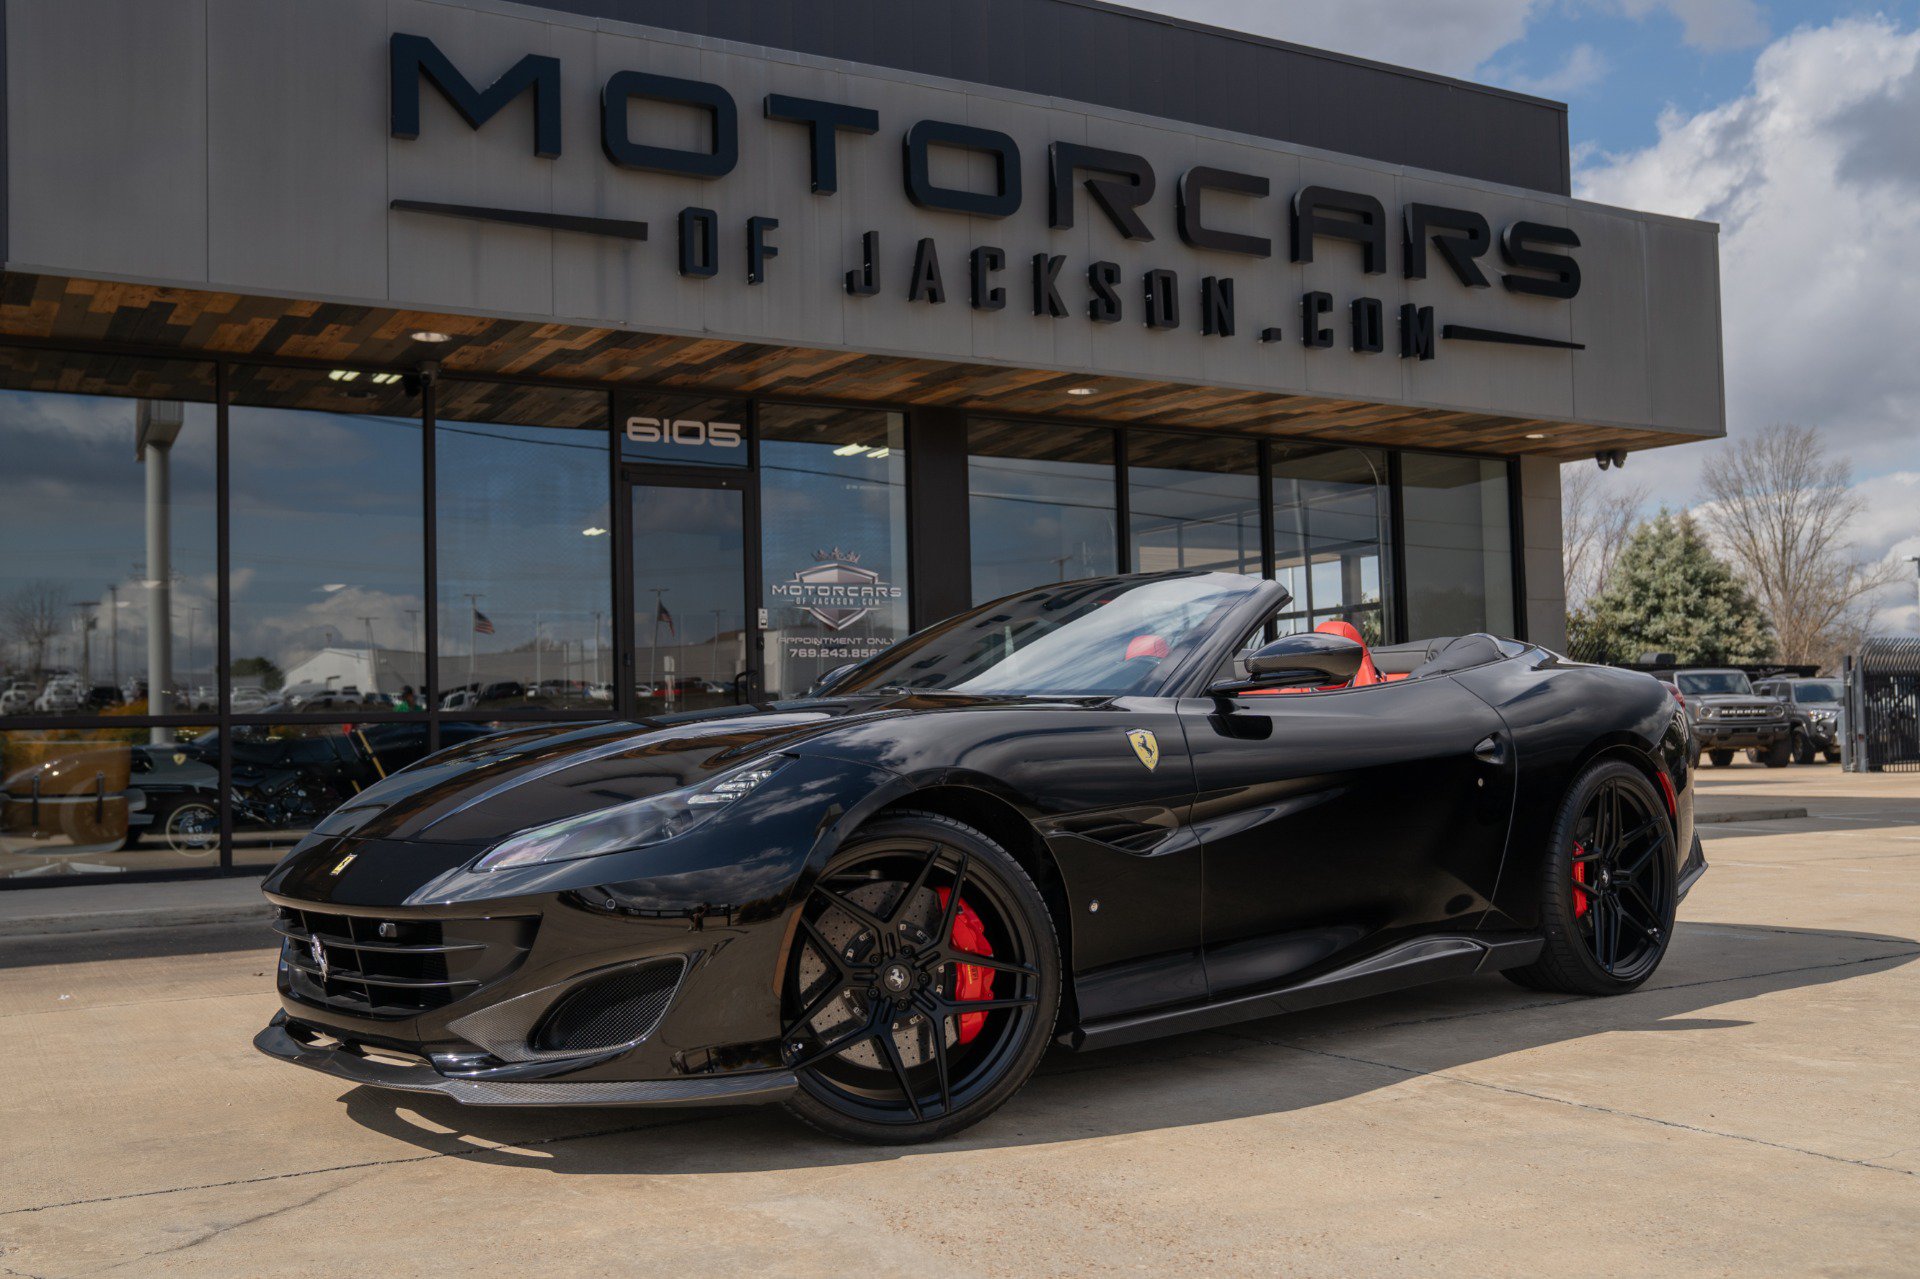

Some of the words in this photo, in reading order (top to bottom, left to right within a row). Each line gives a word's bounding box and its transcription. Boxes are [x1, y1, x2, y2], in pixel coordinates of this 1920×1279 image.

[390, 32, 1582, 299] MOTORCARS
[677, 206, 779, 286] OF
[844, 230, 1435, 361] JACKSON.COM
[626, 416, 741, 448] 6105
[771, 584, 902, 598] MOTORCARS
[795, 596, 807, 606] OF
[778, 637, 863, 646] APPOINTMENT
[866, 637, 897, 646] ONLY
